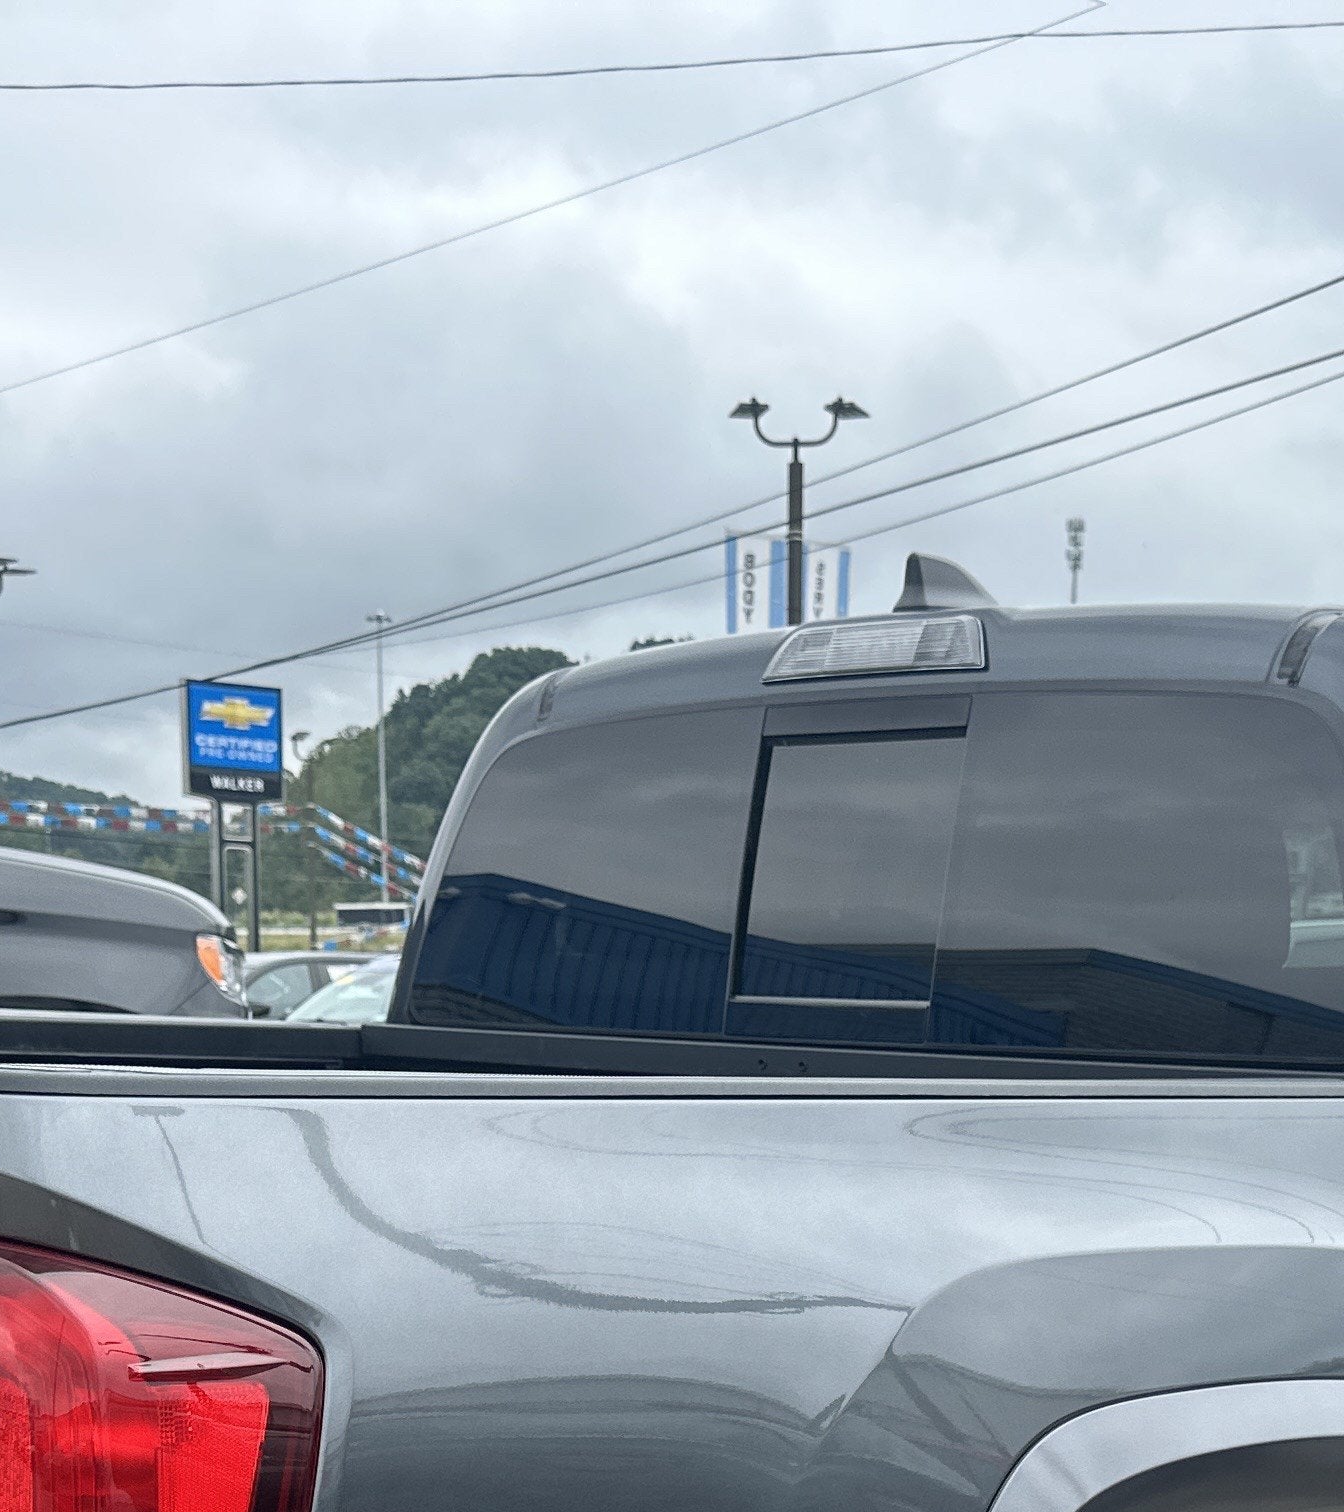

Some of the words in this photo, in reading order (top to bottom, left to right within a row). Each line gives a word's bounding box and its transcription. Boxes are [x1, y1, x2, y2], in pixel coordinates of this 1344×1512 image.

[742, 554, 756, 624] BODY
[194, 732, 278, 753] CERTIFIED
[209, 775, 265, 793] WALKER
